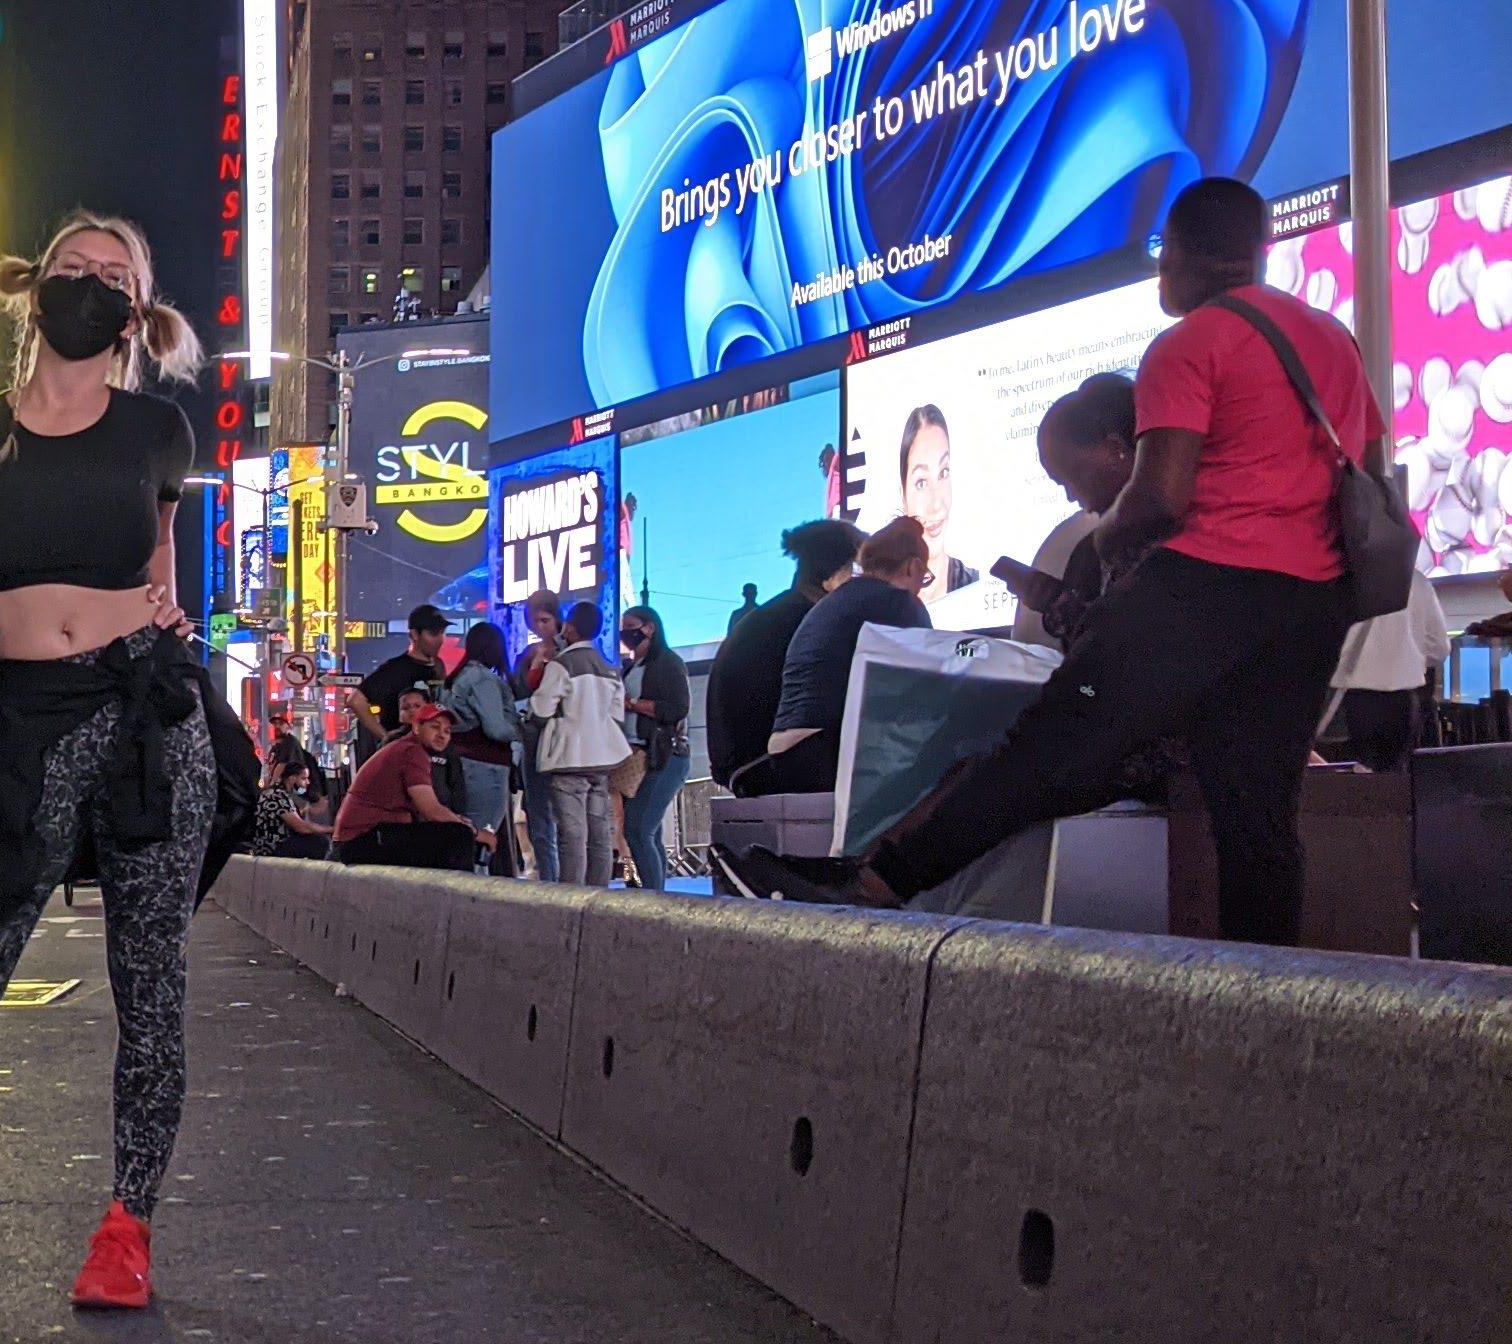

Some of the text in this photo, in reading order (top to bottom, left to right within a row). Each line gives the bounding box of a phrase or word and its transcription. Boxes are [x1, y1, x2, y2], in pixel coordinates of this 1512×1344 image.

[629, 12, 671, 44] MARQUIS
[835, 0, 915, 58] Windows
[660, 171, 730, 233] Brings
[735, 149, 781, 215] you
[788, 111, 867, 177] closer
[873, 96, 904, 141] to
[910, 49, 988, 125] what
[994, 26, 1058, 107] you
[217, 75, 241, 257] ERNST
[1272, 185, 1339, 217] MARRIOTT
[1272, 206, 1330, 234] MARQUIS
[790, 233, 953, 308] Available this October
[218, 295, 241, 325] &
[868, 316, 911, 339] MARRIOTT
[868, 333, 906, 354] MARQUIS
[376, 441, 486, 482] STYL
[392, 484, 481, 499] BANGKO
[503, 471, 598, 543] HOWARD'S
[502, 525, 597, 604] LIVE
[983, 591, 1018, 610] SEPH
